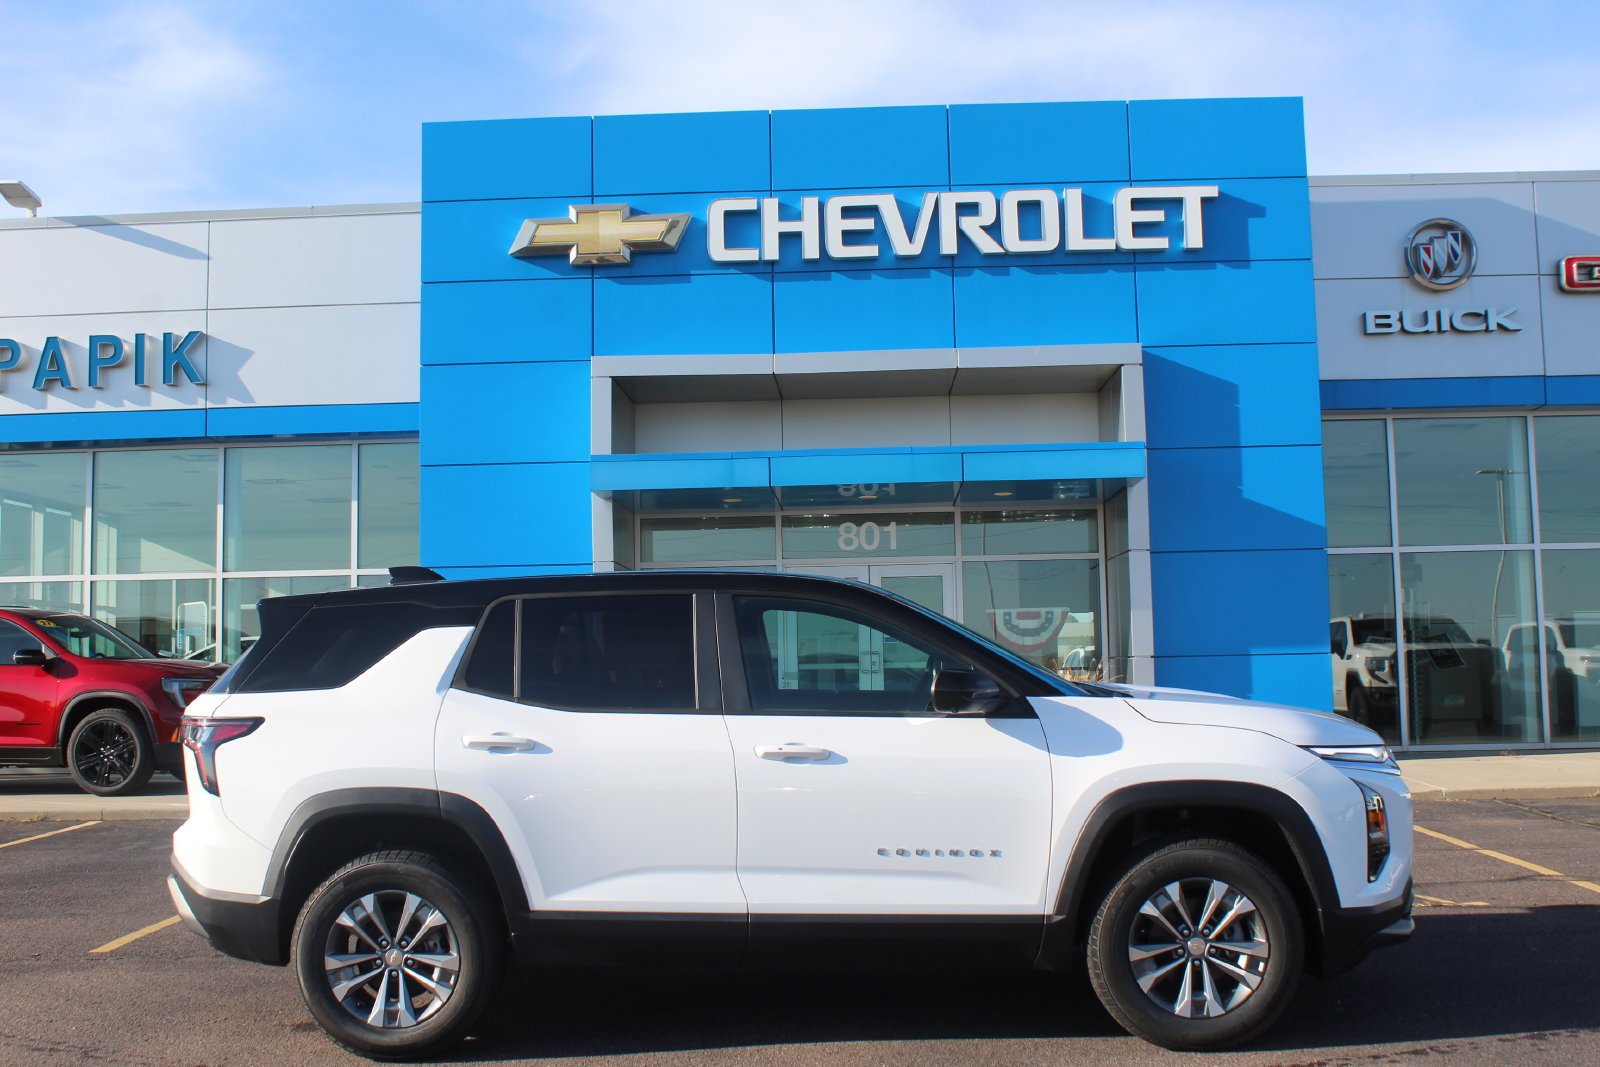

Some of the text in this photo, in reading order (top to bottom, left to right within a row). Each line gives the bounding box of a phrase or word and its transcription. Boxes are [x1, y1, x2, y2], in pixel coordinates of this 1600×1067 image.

[706, 186, 1218, 263] CHEVROLET
[1363, 307, 1522, 335] BUICK
[838, 521, 897, 551] 801
